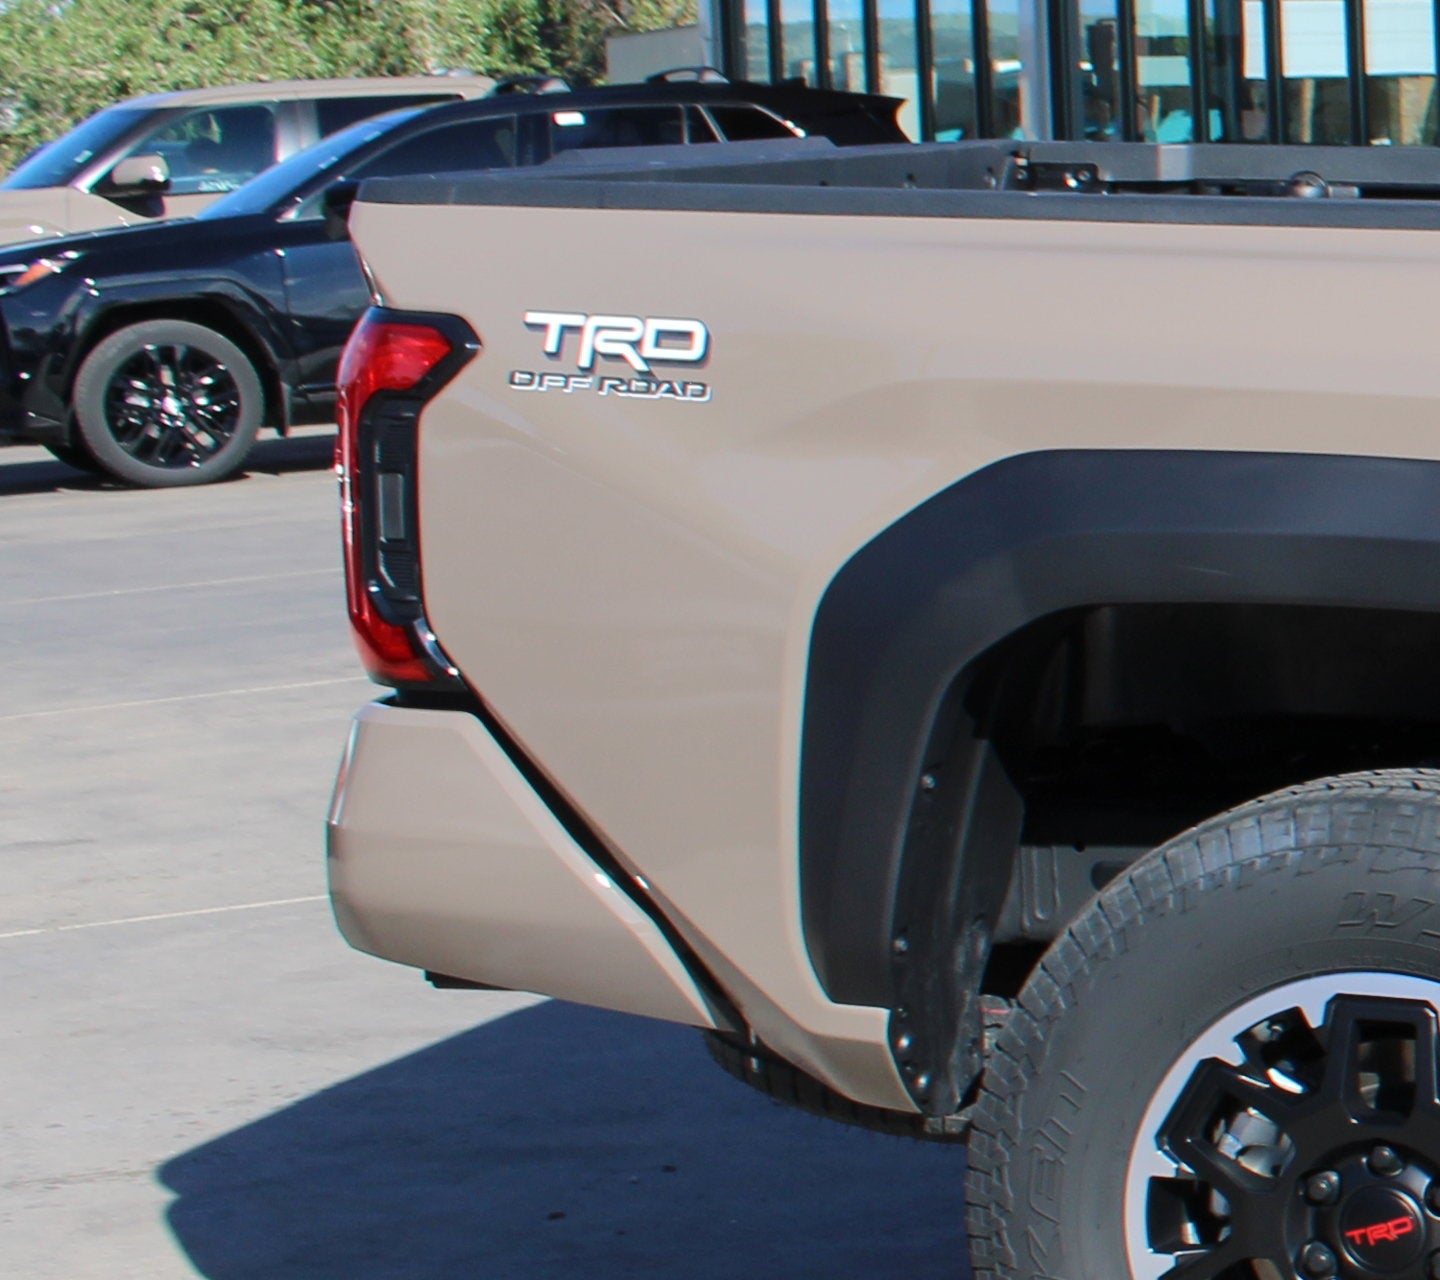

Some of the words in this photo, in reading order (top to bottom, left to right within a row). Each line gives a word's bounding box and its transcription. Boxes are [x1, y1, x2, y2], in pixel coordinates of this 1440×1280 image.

[523, 310, 712, 375] TRD
[508, 370, 594, 394] OFF
[598, 375, 712, 402] ROAD
[1344, 1215, 1415, 1248] TRD
